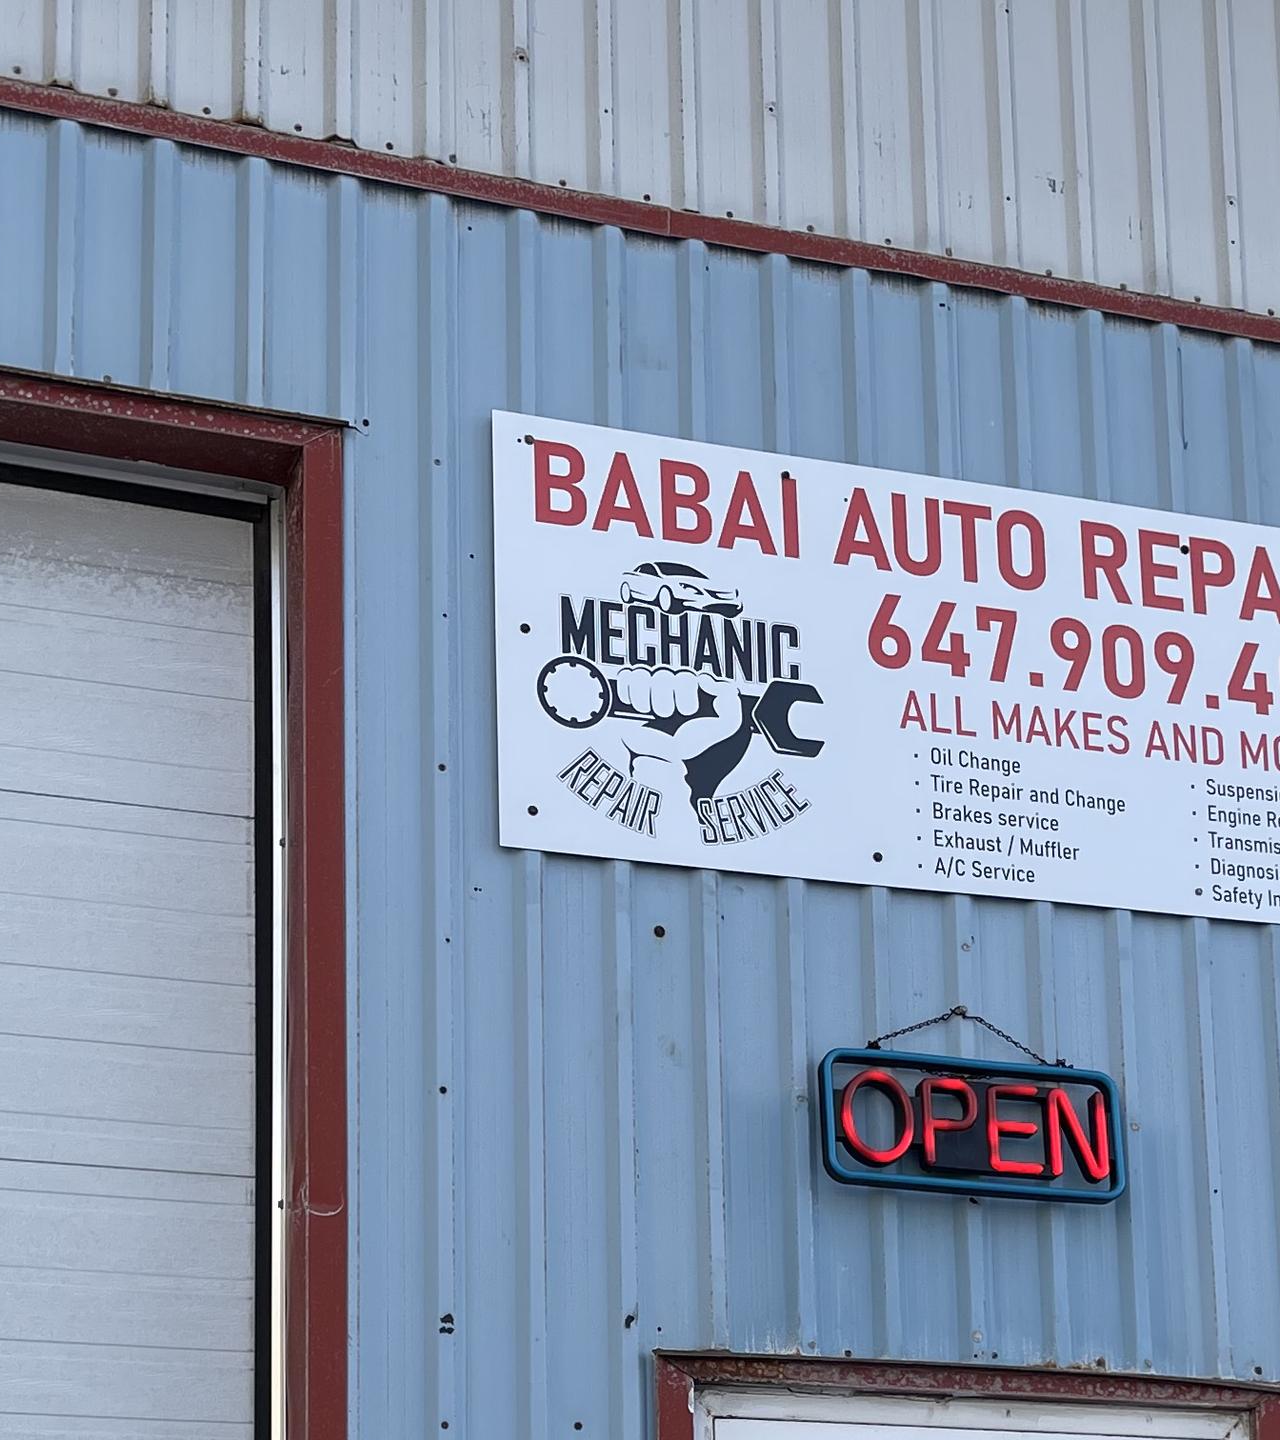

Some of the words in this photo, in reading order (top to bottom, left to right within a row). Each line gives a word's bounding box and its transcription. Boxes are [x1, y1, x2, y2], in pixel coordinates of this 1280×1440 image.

[534, 439, 800, 559] BABAI
[833, 487, 1046, 591] AUTO
[560, 594, 800, 684] MECHANIC
[899, 690, 977, 738] ALL
[992, 701, 1130, 754] MAKES
[1145, 721, 1224, 766] AND
[930, 747, 953, 766] Oil
[958, 750, 1021, 776] Change
[558, 747, 662, 838] REPAIR
[696, 769, 811, 846] SERVICE
[930, 774, 963, 794] Tire
[969, 778, 1023, 802] Repair
[1029, 788, 1059, 804] and
[1065, 789, 1126, 815] Change
[932, 802, 992, 824] Brakes
[998, 812, 1059, 831] service
[1208, 805, 1261, 828] Engine
[934, 830, 1002, 853] Exhaust
[1007, 835, 1015, 857] /
[1020, 838, 1080, 860] Muffler
[934, 857, 966, 878] A/C
[972, 860, 1035, 882] Service
[1212, 884, 1263, 910] Safety
[841, 1069, 1110, 1180] OPEN
